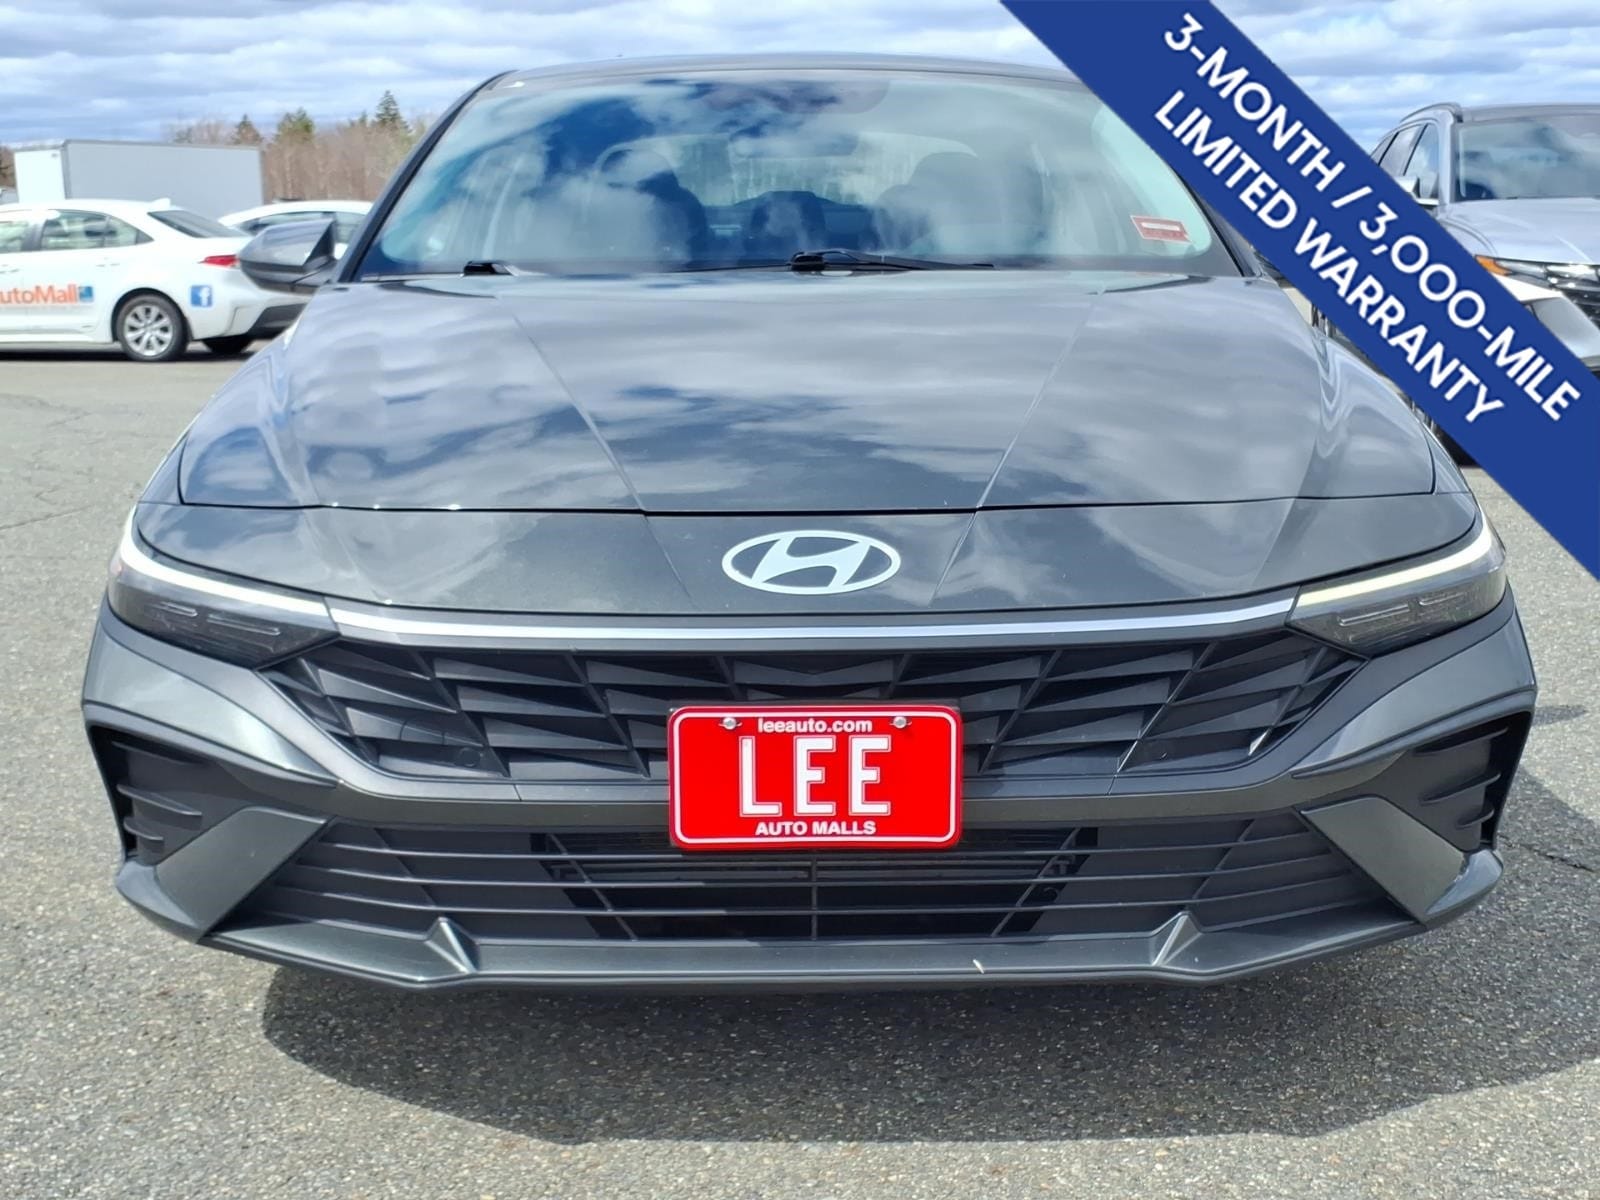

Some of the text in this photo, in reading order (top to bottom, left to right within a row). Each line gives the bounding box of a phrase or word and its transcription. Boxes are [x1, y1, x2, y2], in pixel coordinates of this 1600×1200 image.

[0, 284, 77, 304] utoMall
[758, 717, 873, 733] leeauto.com
[739, 734, 891, 817] LEE
[755, 820, 877, 836] AUTO MALLS
